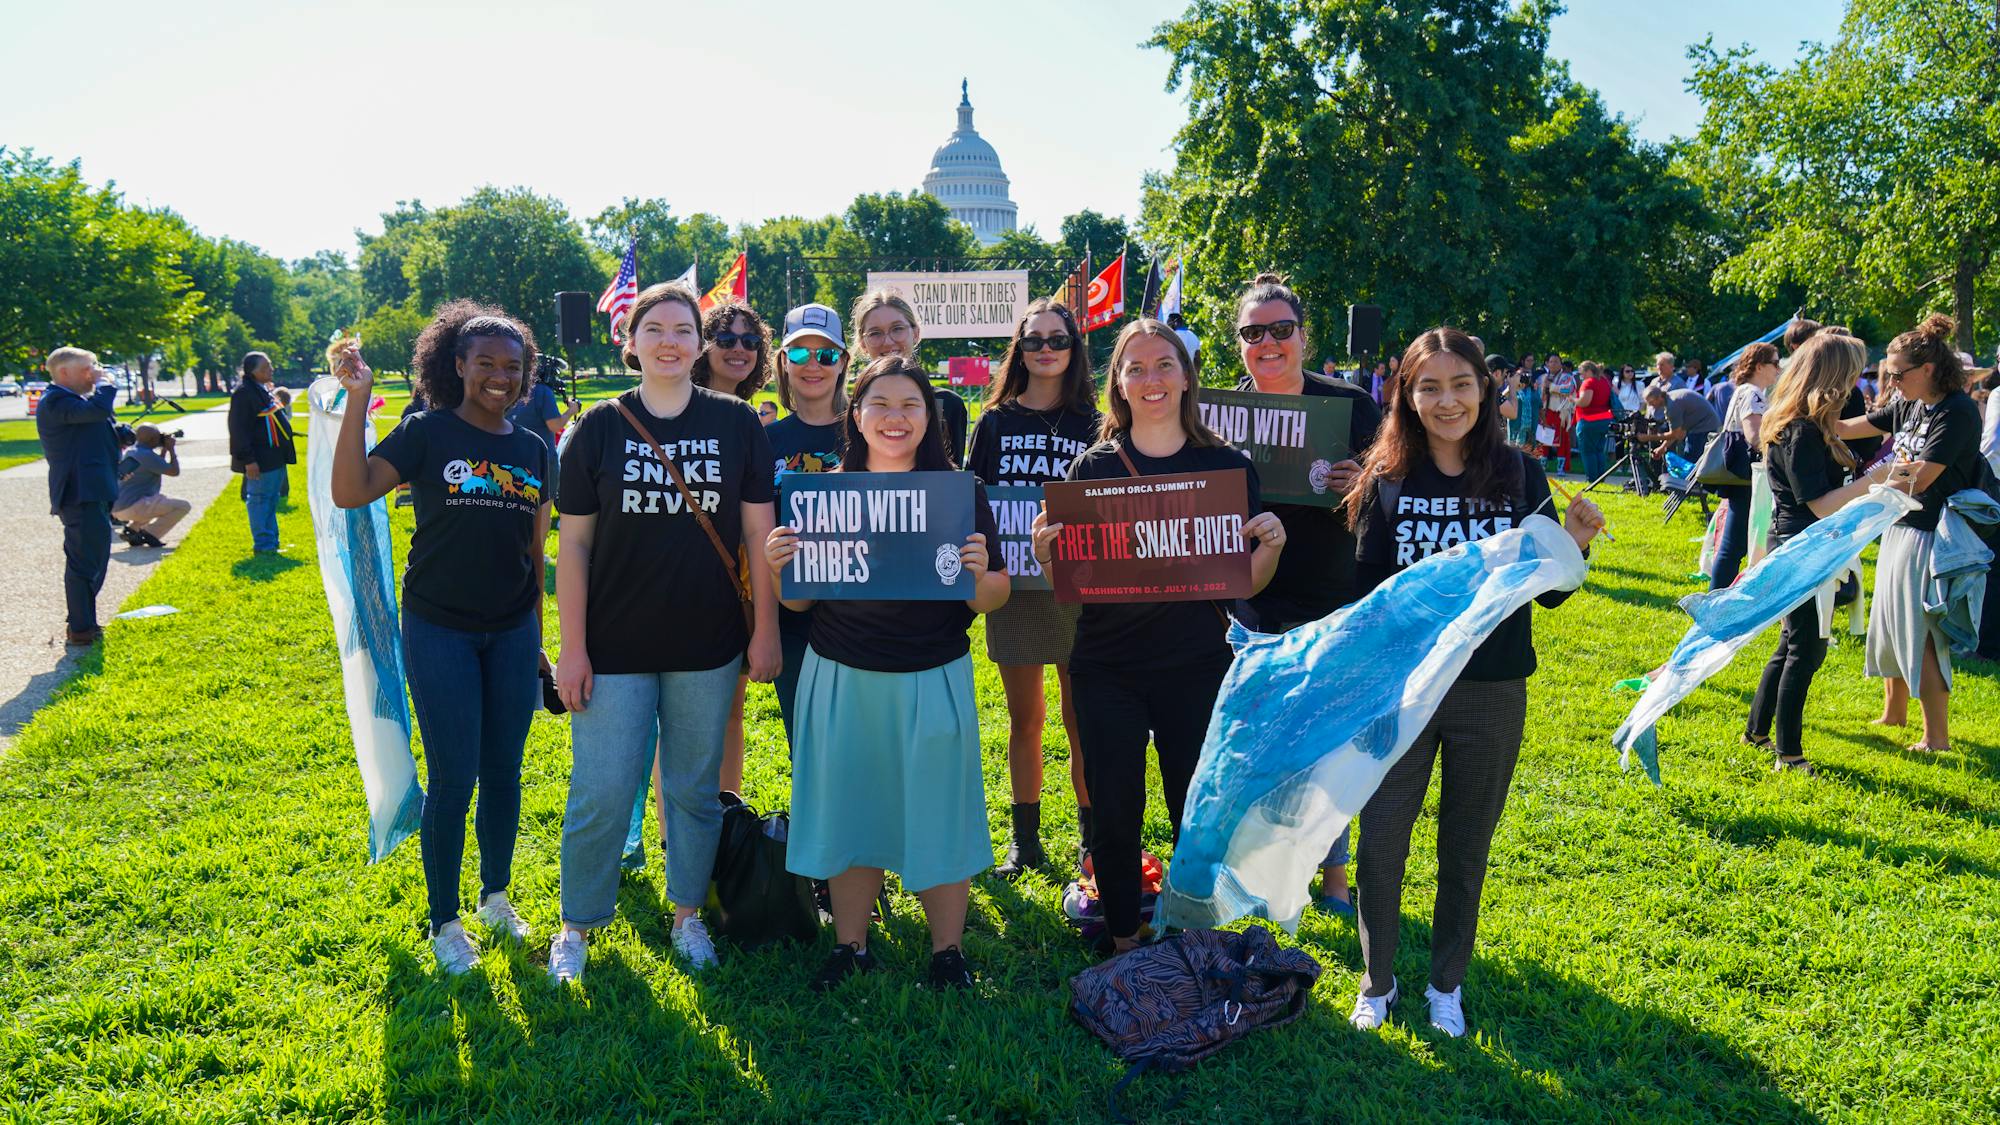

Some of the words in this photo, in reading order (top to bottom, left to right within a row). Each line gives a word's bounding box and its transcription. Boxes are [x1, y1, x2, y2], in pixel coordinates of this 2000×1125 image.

[914, 283, 946, 304] STAND
[950, 283, 976, 303] WITH
[981, 283, 1016, 303] TRIBES
[917, 305, 942, 325] SAVE
[946, 305, 966, 325] OUR
[970, 304, 1013, 324] SALMON
[1198, 402, 1248, 443] TAND
[1254, 407, 1306, 448] WITH
[625, 439, 677, 460] FRE
[678, 439, 720, 456] THE
[1001, 434, 1047, 451] FREE
[1051, 436, 1087, 456] THE
[999, 454, 1071, 479] SNAK
[1085, 486, 1125, 497] SALMON
[1127, 485, 1153, 494] ORCA
[1155, 481, 1194, 492] SUMMIT
[1196, 480, 1207, 489] IV
[446, 498, 504, 508] DEFENDERS
[506, 502, 518, 510] OF
[520, 504, 536, 515] WILD
[790, 490, 861, 534] STAND
[867, 489, 927, 533] WITH
[1398, 496, 1460, 516] FREE
[989, 500, 1037, 535] TAND
[1058, 523, 1097, 561] FREE
[1100, 521, 1132, 560] THE
[1135, 518, 1191, 559] SNAKE
[1194, 513, 1245, 556] RIVER
[1395, 517, 1512, 543] SNAKE
[793, 540, 870, 584] TRIBES
[1080, 586, 1142, 596] WASHINGTON
[1144, 586, 1161, 594] D.C.
[1164, 584, 1187, 593] JULY
[1204, 582, 1227, 591] 2022
